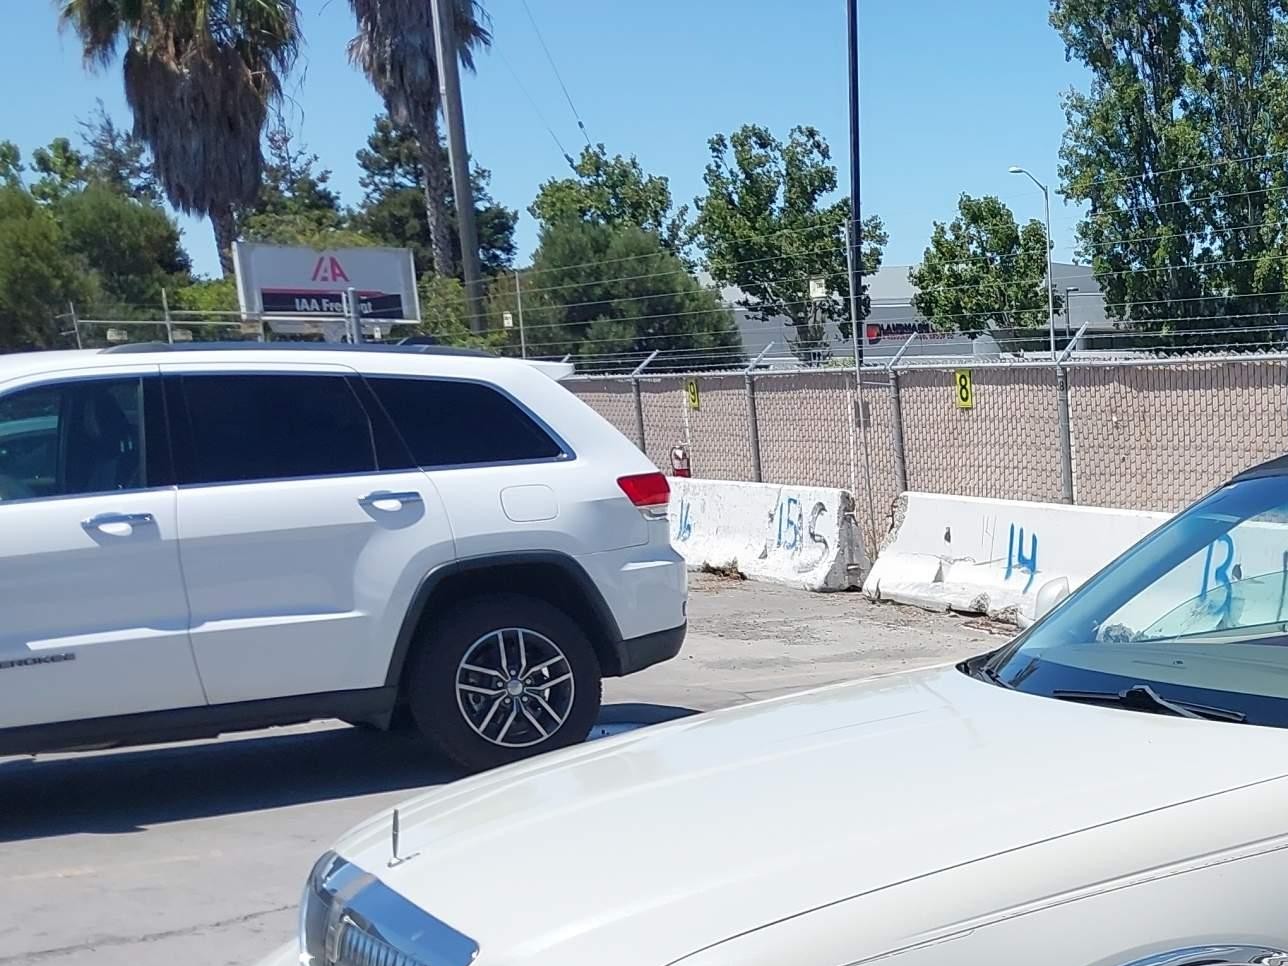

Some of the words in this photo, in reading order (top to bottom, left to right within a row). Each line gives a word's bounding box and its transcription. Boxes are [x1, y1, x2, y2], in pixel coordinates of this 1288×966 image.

[295, 298, 320, 311] IAA
[690, 381, 696, 403] 9
[959, 374, 969, 402] 8
[677, 499, 694, 541] 16
[1004, 522, 1038, 594] 14
